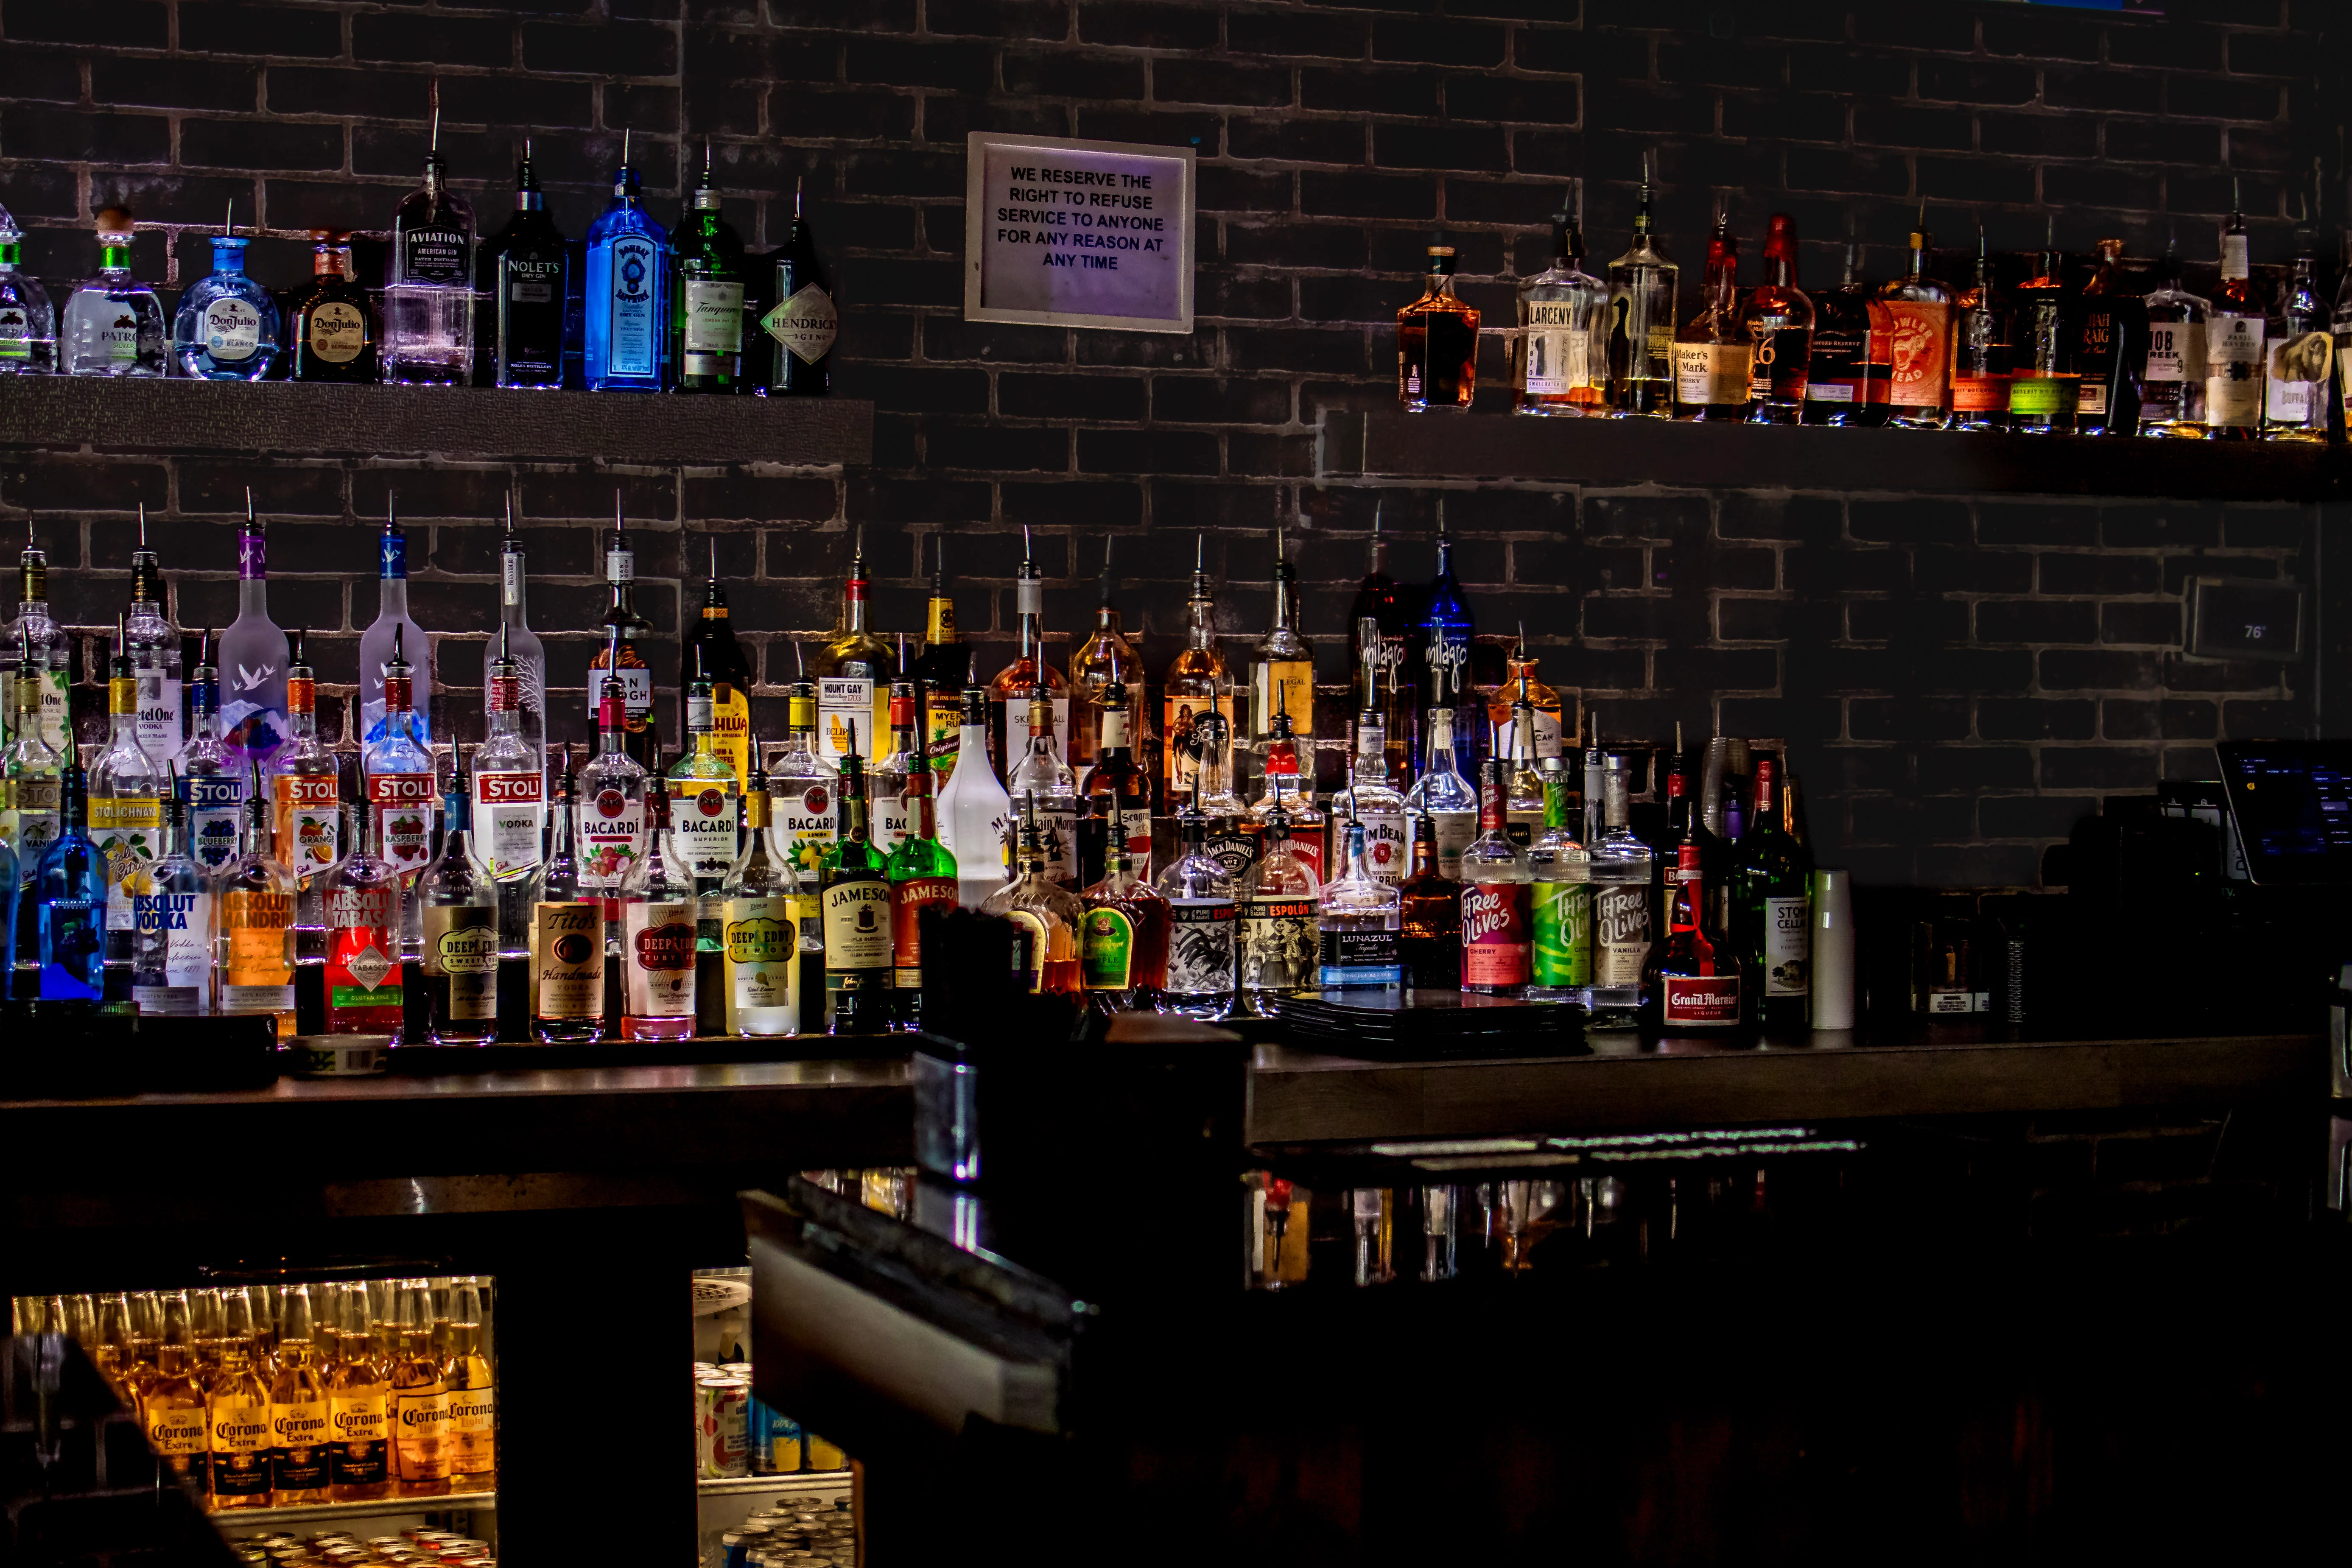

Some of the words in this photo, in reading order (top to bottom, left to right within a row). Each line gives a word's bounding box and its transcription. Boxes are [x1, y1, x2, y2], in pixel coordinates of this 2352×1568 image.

[1011, 167, 1036, 181] WE
[1042, 169, 1116, 186] RESERVE
[1121, 175, 1152, 189] THE
[1010, 188, 1059, 203] RIGHT
[1064, 191, 1085, 205] TO
[1090, 193, 1153, 210] REFUSE
[998, 208, 1066, 225] SERVICE
[1071, 213, 1093, 227] TO
[1097, 215, 1164, 231] ANYONE
[411, 233, 464, 244] AVIATION
[998, 229, 1031, 243] FOR
[1035, 232, 1068, 246] ANY
[1073, 234, 1140, 251] REASON
[1144, 238, 1163, 252] AT
[509, 260, 560, 273] NOLET'S
[1043, 253, 1077, 268] ANY
[1081, 255, 1118, 270] TIME
[1530, 307, 1572, 325] LARCENY
[1676, 350, 1708, 360] Maker's
[1682, 363, 1708, 372] Mark
[2177, 359, 2183, 373] 9
[1363, 628, 1404, 694] milagro
[1426, 628, 1467, 693] milagro
[825, 684, 845, 693] MOUNT
[847, 684, 862, 693] GAY
[155, 708, 174, 721] One
[190, 783, 241, 801] STOLI
[378, 780, 430, 797] STOLI
[488, 780, 539, 797] STOLI
[94, 806, 157, 818] STOLICHNAYA
[499, 820, 533, 828] VODKA
[585, 817, 639, 835] BACARDÍ
[683, 816, 735, 833] BACARDÍ
[788, 813, 837, 830] BACARDÍ
[198, 836, 238, 846] BLUEBERRY
[299, 835, 334, 844] ORANGE
[385, 834, 427, 843] RASPBERRY
[1207, 844, 1224, 859] JACK
[1225, 840, 1254, 858] DANIEL'S
[134, 895, 195, 912] ABSOLUT
[832, 887, 890, 908] JAMESON
[136, 913, 188, 930] VODKA
[548, 911, 597, 930] Tito's
[643, 938, 671, 950] DEEP
[731, 931, 754, 943] DEEP
[764, 930, 790, 942] EDDY
[1342, 934, 1393, 942] LUNAZUL
[447, 941, 475, 953] DEEP
[1355, 943, 1379, 953] Tequila
[543, 967, 601, 981] Handmade
[1671, 993, 1703, 1006] Grand
[1703, 993, 1738, 1005] Marnier
[403, 1408, 449, 1425] Corona
[448, 1402, 493, 1420] Corona
[274, 1417, 325, 1434] Corona
[334, 1411, 383, 1429] Corona
[152, 1424, 204, 1442] Corona
[216, 1421, 266, 1439] Corona
[286, 1432, 314, 1442] Extra
[347, 1426, 374, 1437] Extra
[165, 1439, 193, 1450] Extra
[229, 1437, 257, 1447] Extra
